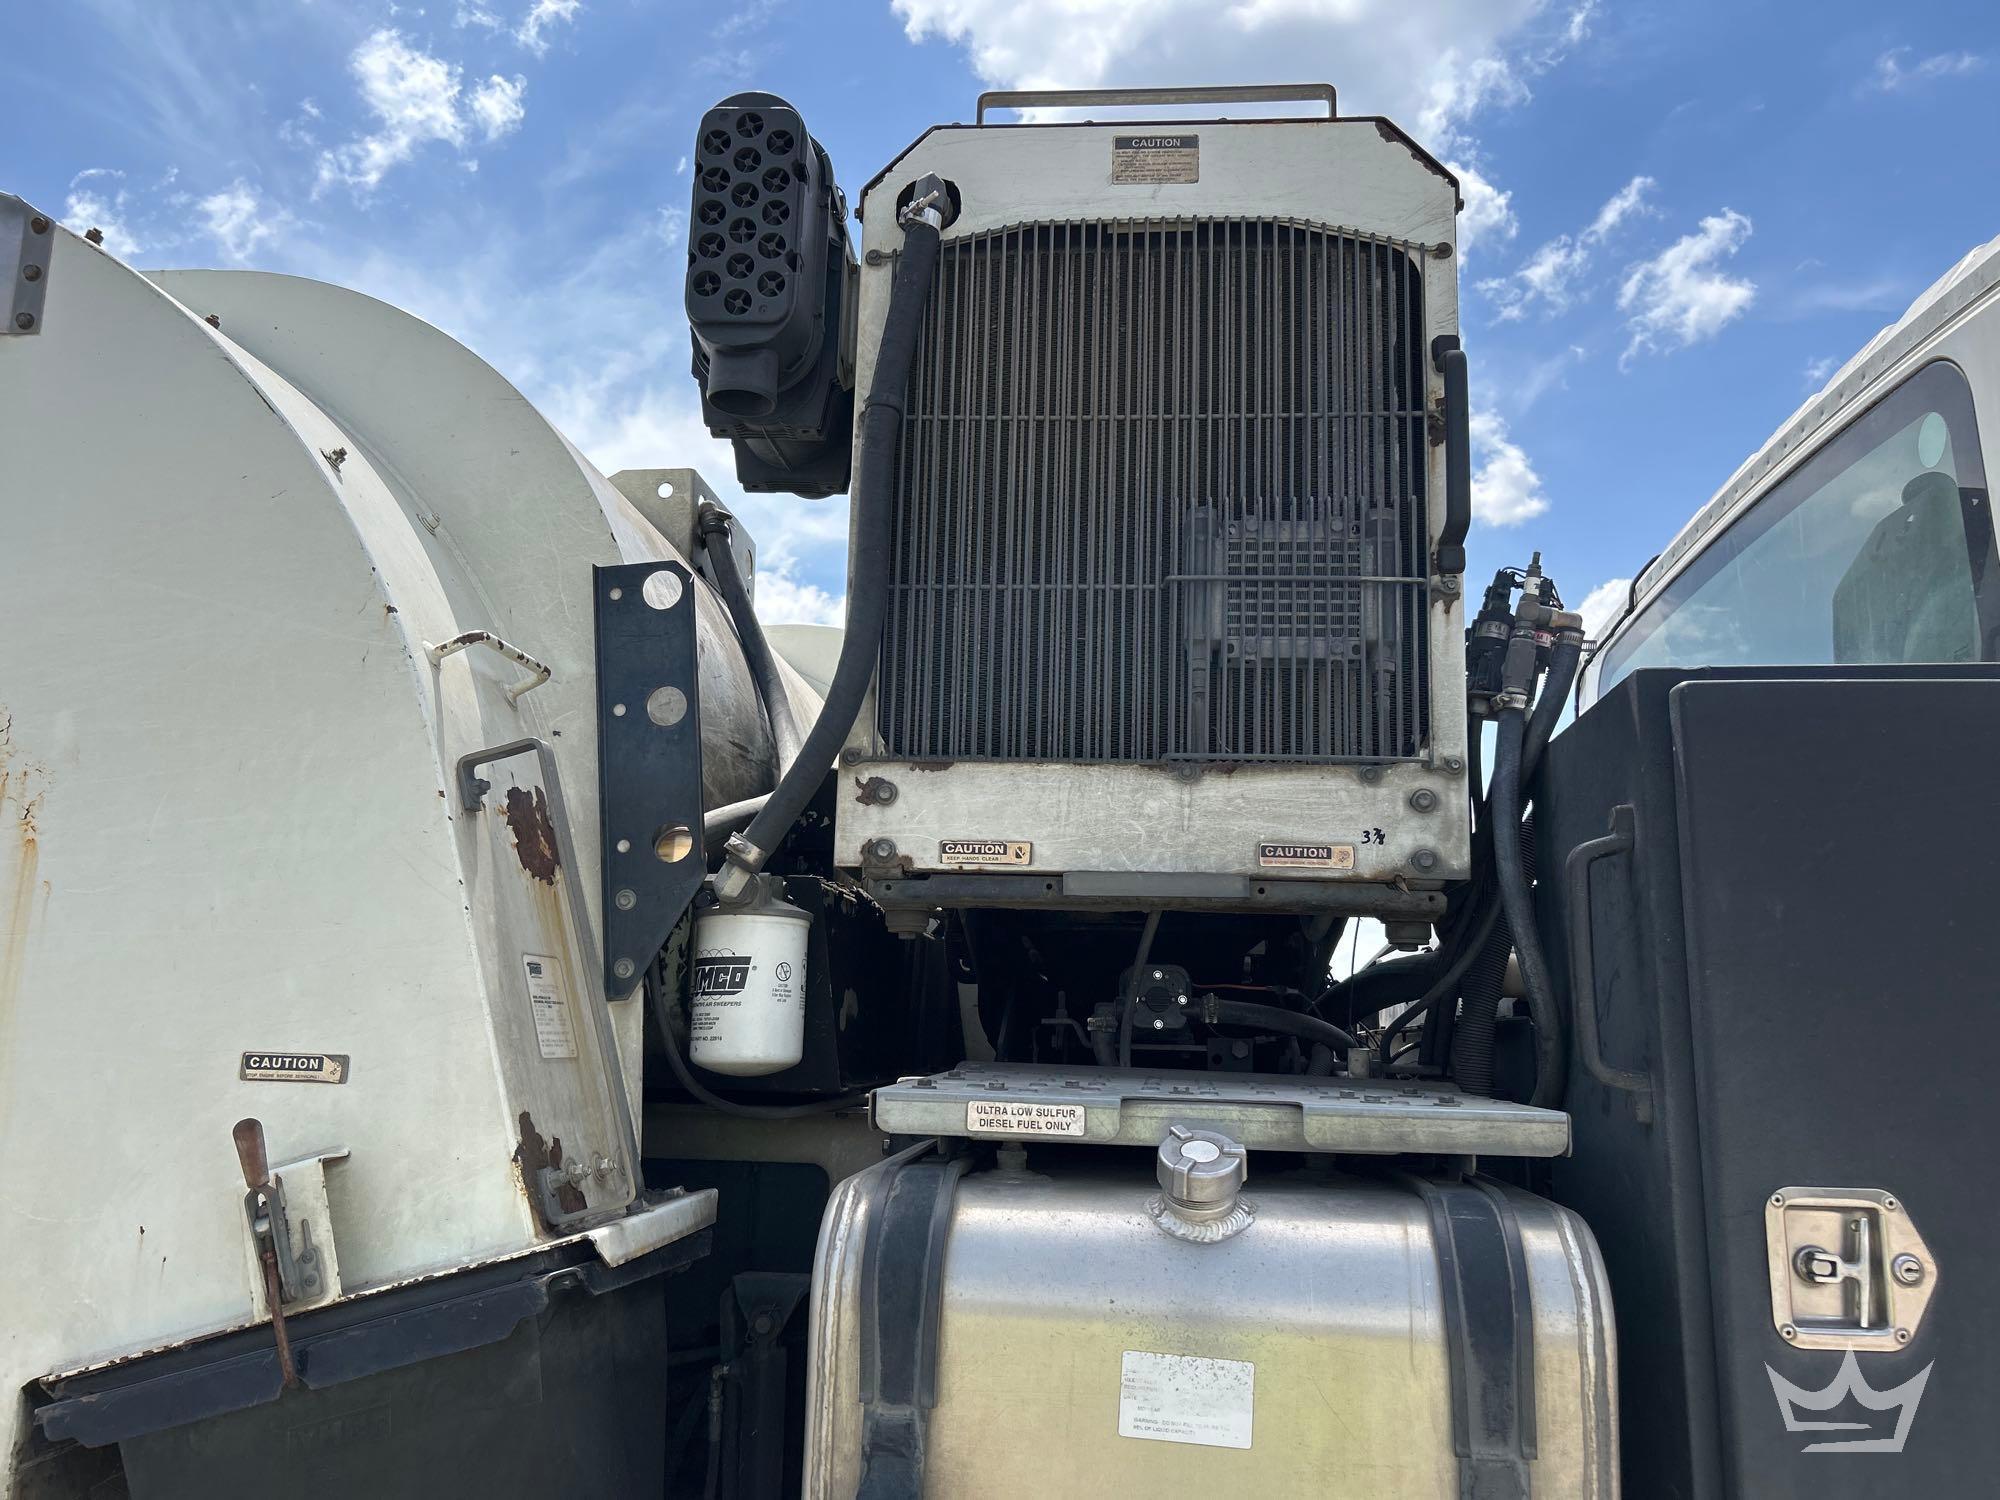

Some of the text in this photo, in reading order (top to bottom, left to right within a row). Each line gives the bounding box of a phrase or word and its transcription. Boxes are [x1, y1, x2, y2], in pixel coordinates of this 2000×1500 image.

[1131, 138, 1181, 148] CAUTION
[1361, 830, 1371, 844] 3
[945, 844, 1005, 854] CAUTION
[1265, 847, 1328, 858] CAUTION
[249, 1056, 319, 1069] CAUTION
[976, 1105, 1076, 1118] ULTRA LOW SULFUR
[979, 1118, 1072, 1131] DIESEL FUEL ONLY
